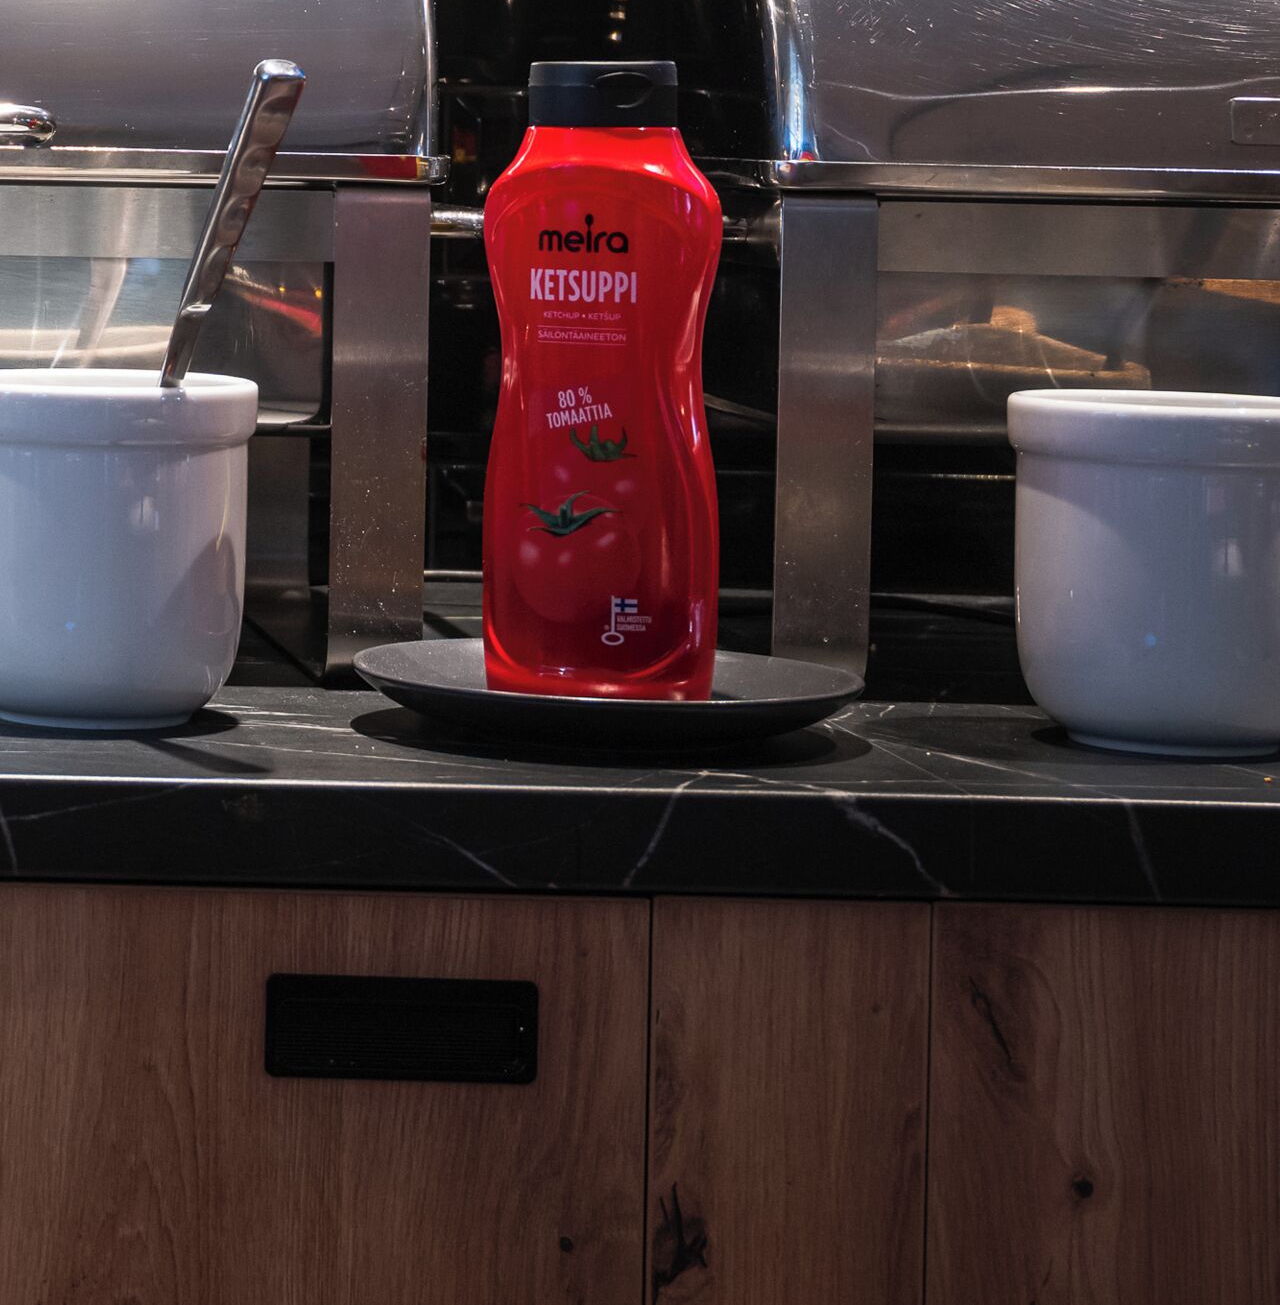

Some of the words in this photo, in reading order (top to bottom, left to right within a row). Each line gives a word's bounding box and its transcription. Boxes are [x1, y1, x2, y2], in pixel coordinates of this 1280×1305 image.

[538, 213, 629, 254] meira
[530, 267, 638, 304] KETSUPPI
[543, 310, 580, 319] KETCHUP
[557, 388, 576, 408] 80
[578, 385, 593, 404] %
[545, 402, 613, 430] TOMAATTIA
